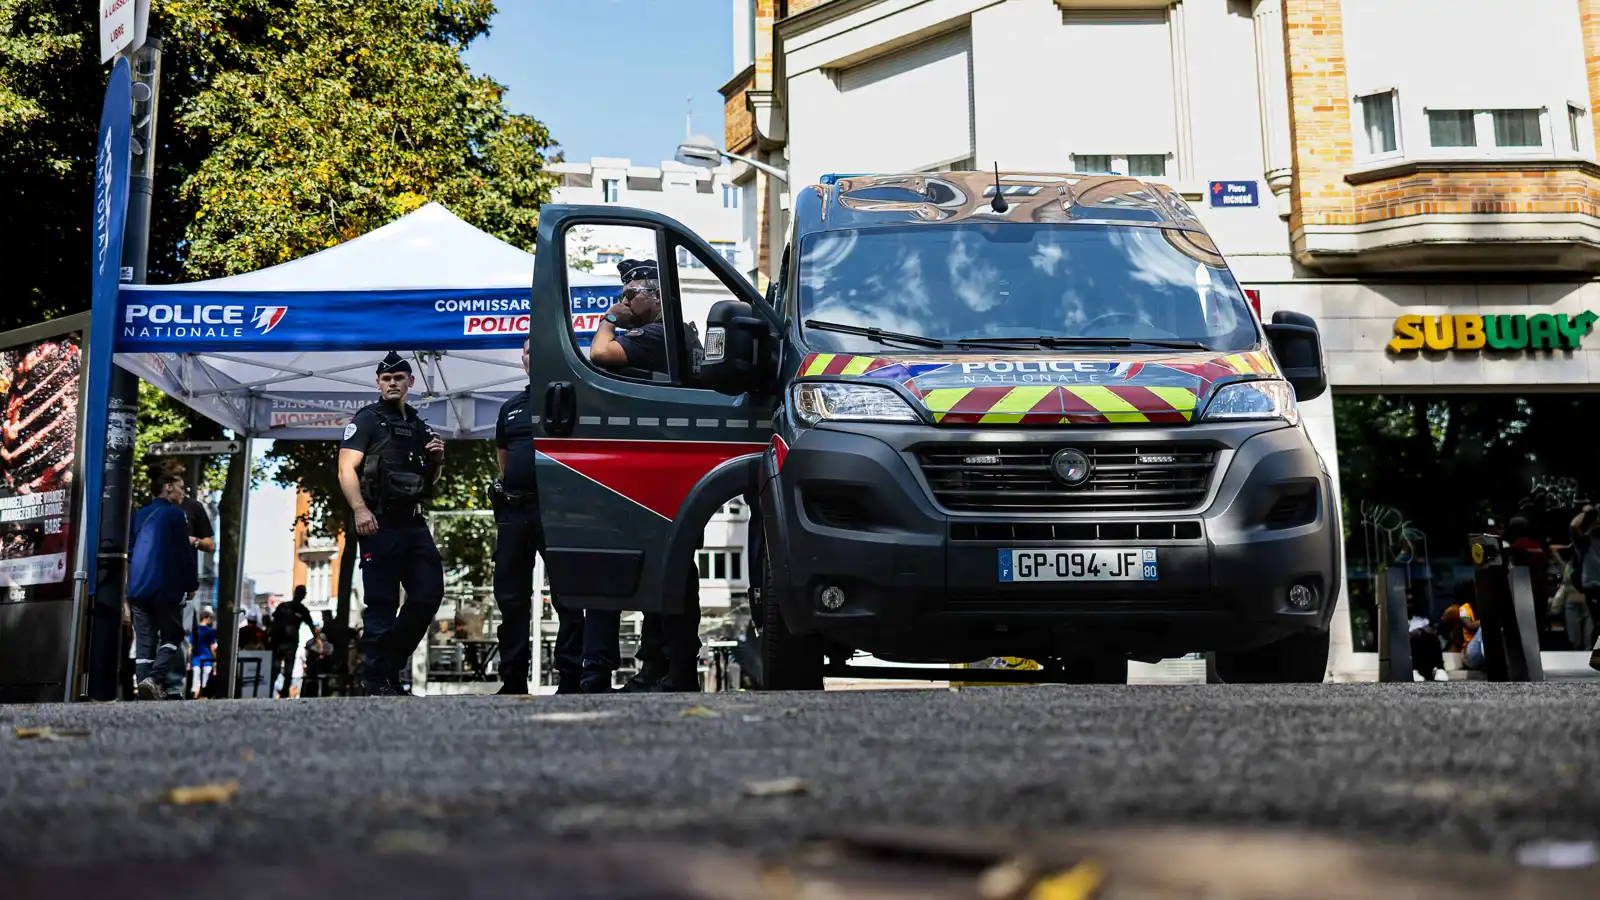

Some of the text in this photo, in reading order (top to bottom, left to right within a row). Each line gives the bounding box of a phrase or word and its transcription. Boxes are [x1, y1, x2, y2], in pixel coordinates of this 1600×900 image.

[109, 0, 130, 16] LAISSE
[110, 23, 125, 43] LIBRE
[1227, 183, 1246, 193] Place
[434, 299, 530, 312] COMMISSAR
[587, 296, 616, 309] POL
[125, 304, 244, 325] POLICE
[124, 327, 243, 337] NATIONALE
[467, 317, 530, 333] POLIC
[1388, 310, 1599, 353] SUBWAY
[961, 360, 1098, 374] POLICE
[963, 373, 1099, 384] NATIONALE
[1003, 552, 1157, 578] F GP-094-JF 80
